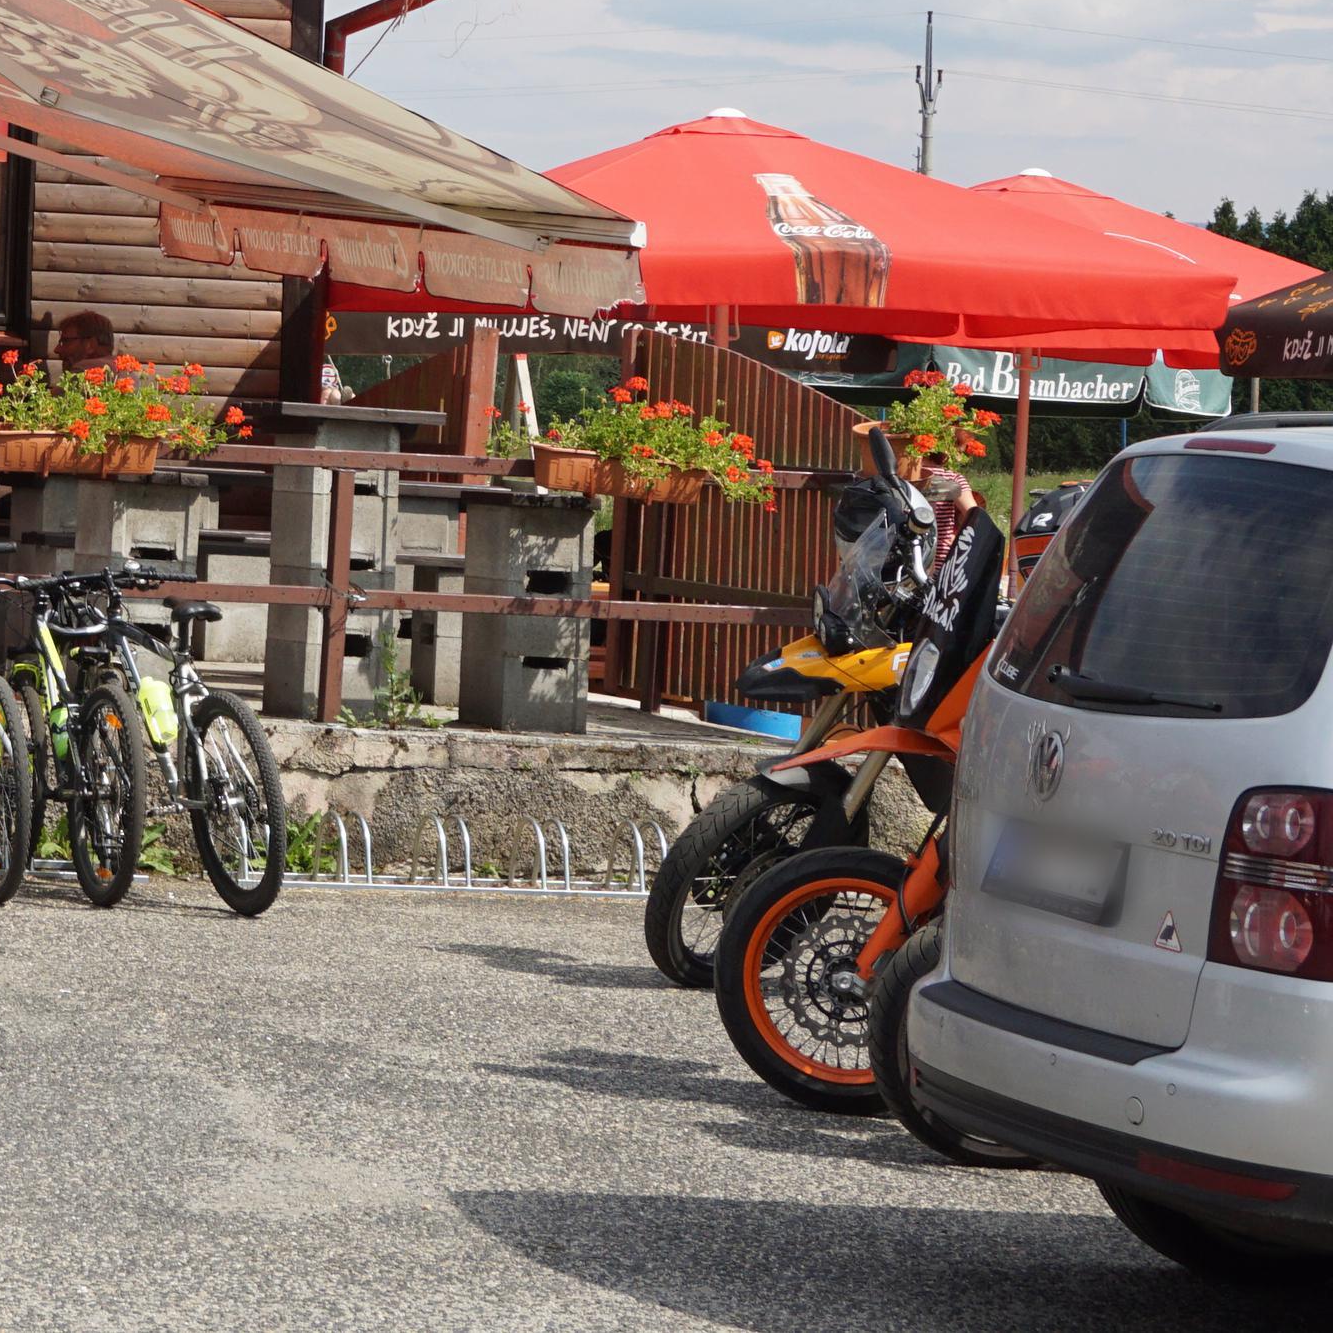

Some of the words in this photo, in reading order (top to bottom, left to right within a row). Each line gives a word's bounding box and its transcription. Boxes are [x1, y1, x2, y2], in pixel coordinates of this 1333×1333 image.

[773, 222, 875, 240] Coca-Cola
[387, 311, 441, 340] KDYŽ
[448, 317, 464, 338] JI
[1282, 330, 1313, 362] KDYŽ
[1315, 335, 1325, 357] JI
[946, 361, 985, 392] Bad
[1181, 832, 1211, 855] TDI
